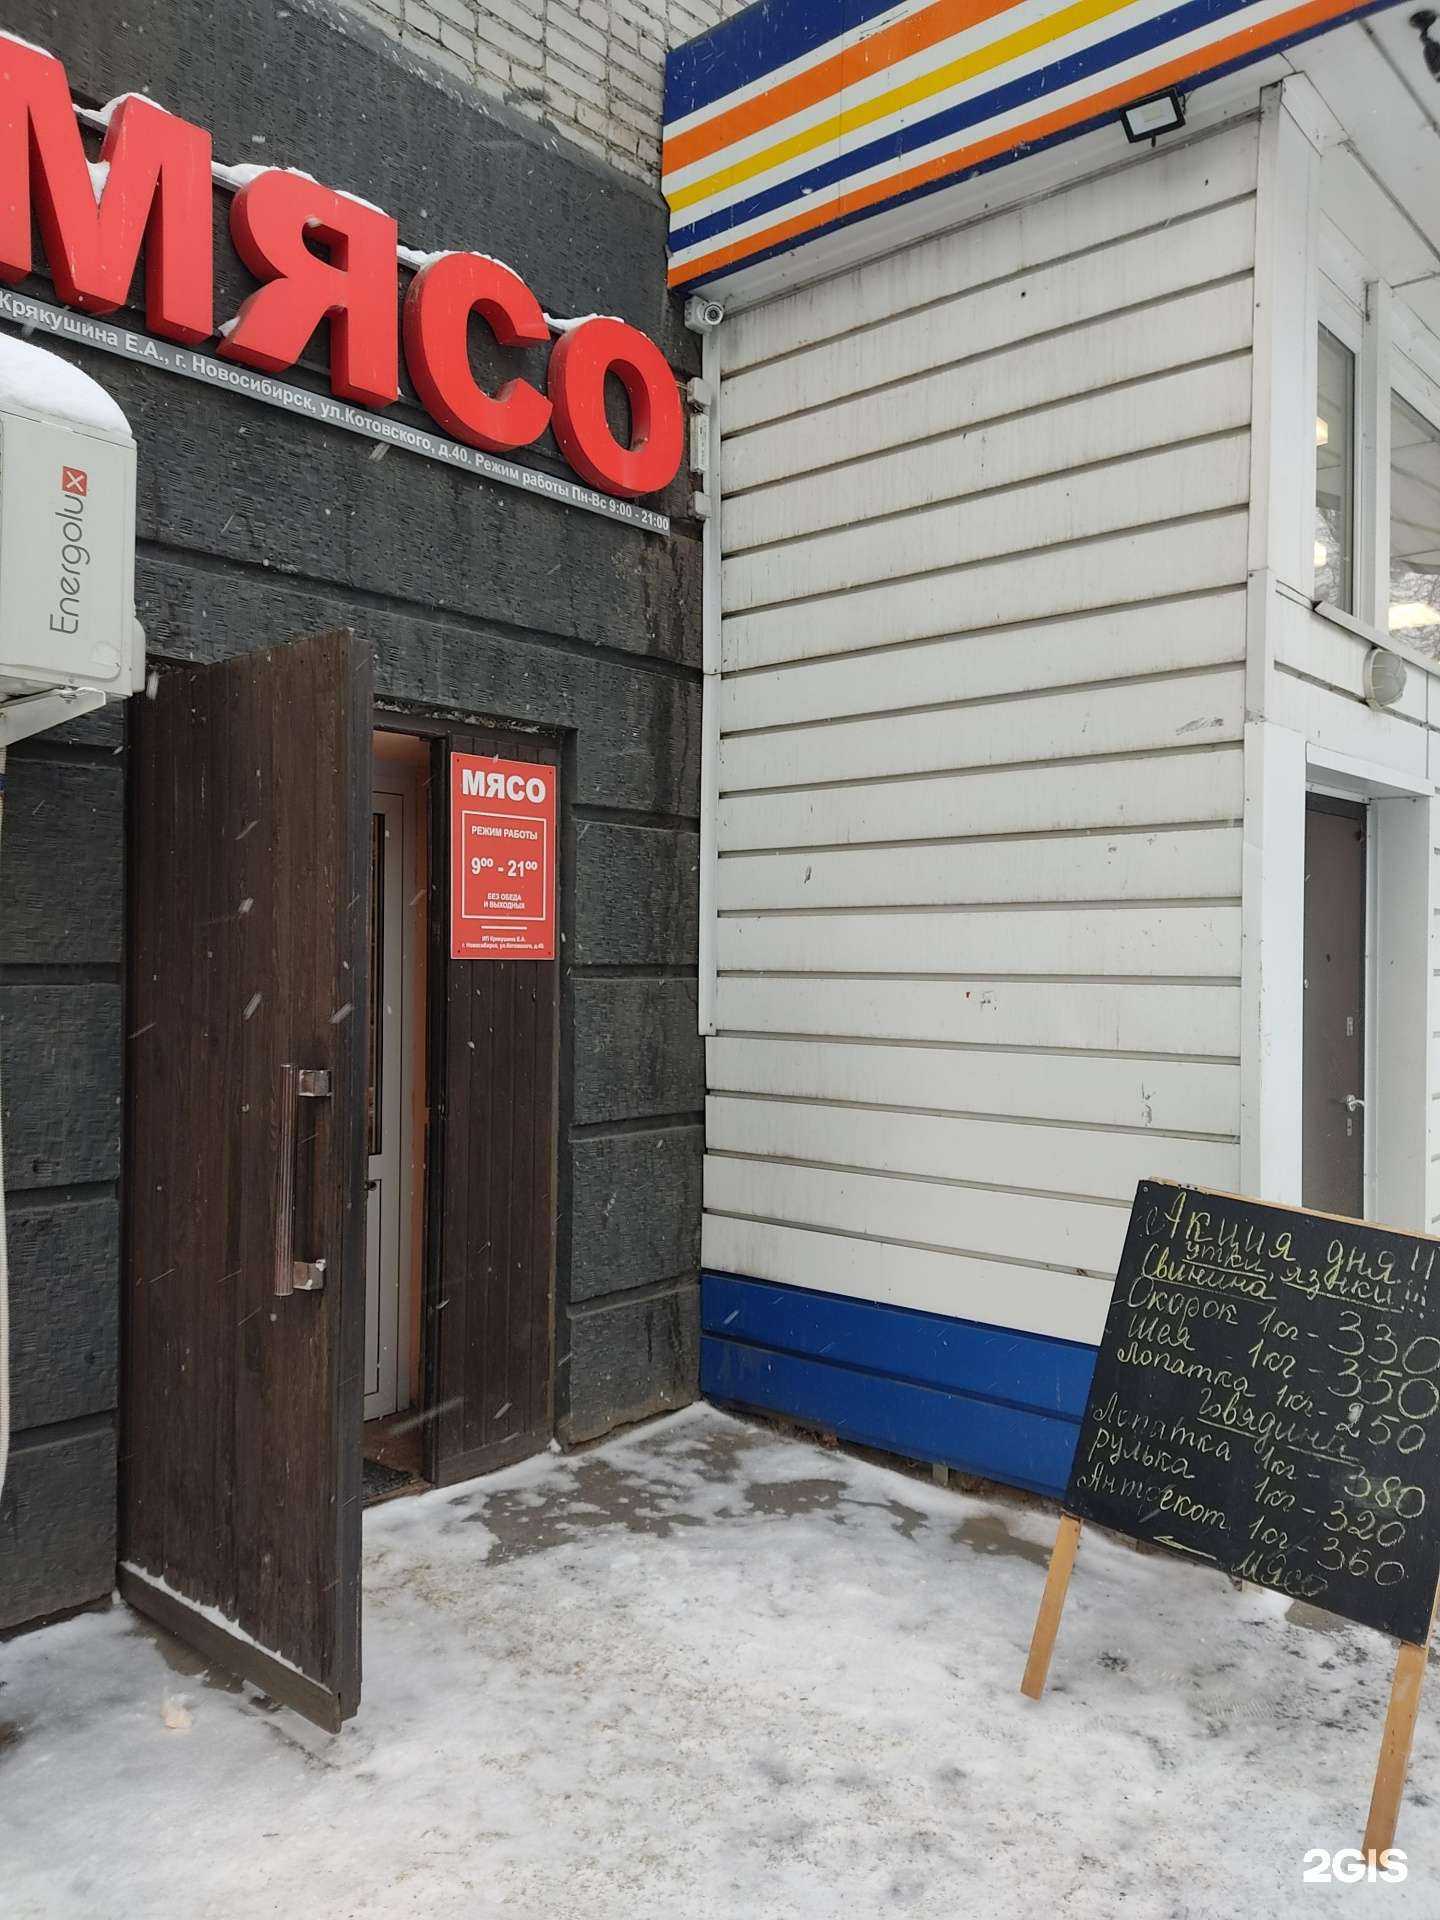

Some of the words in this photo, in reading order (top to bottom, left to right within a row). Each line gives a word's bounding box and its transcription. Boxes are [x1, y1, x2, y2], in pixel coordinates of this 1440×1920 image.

[0, 291, 118, 347] Крякушина
[175, 354, 187, 369] г.
[192, 355, 317, 413] Новосибирск,
[475, 453, 519, 481] Режим
[522, 472, 569, 498] работы
[571, 487, 607, 510] Пн-Вс
[609, 498, 633, 518] 9:00
[641, 511, 670, 531] 21:00
[462, 769, 546, 804] МЯСО
[471, 825, 502, 838] РЕЖИМ
[503, 828, 538, 841] РАБОТЫ
[1328, 1310, 1440, 1374] 330
[1327, 1358, 1439, 1420] 350
[1335, 1402, 1426, 1454] 250
[1344, 1466, 1425, 1518] 380
[1323, 1500, 1405, 1547] 320
[1317, 1537, 1405, 1585] 360
